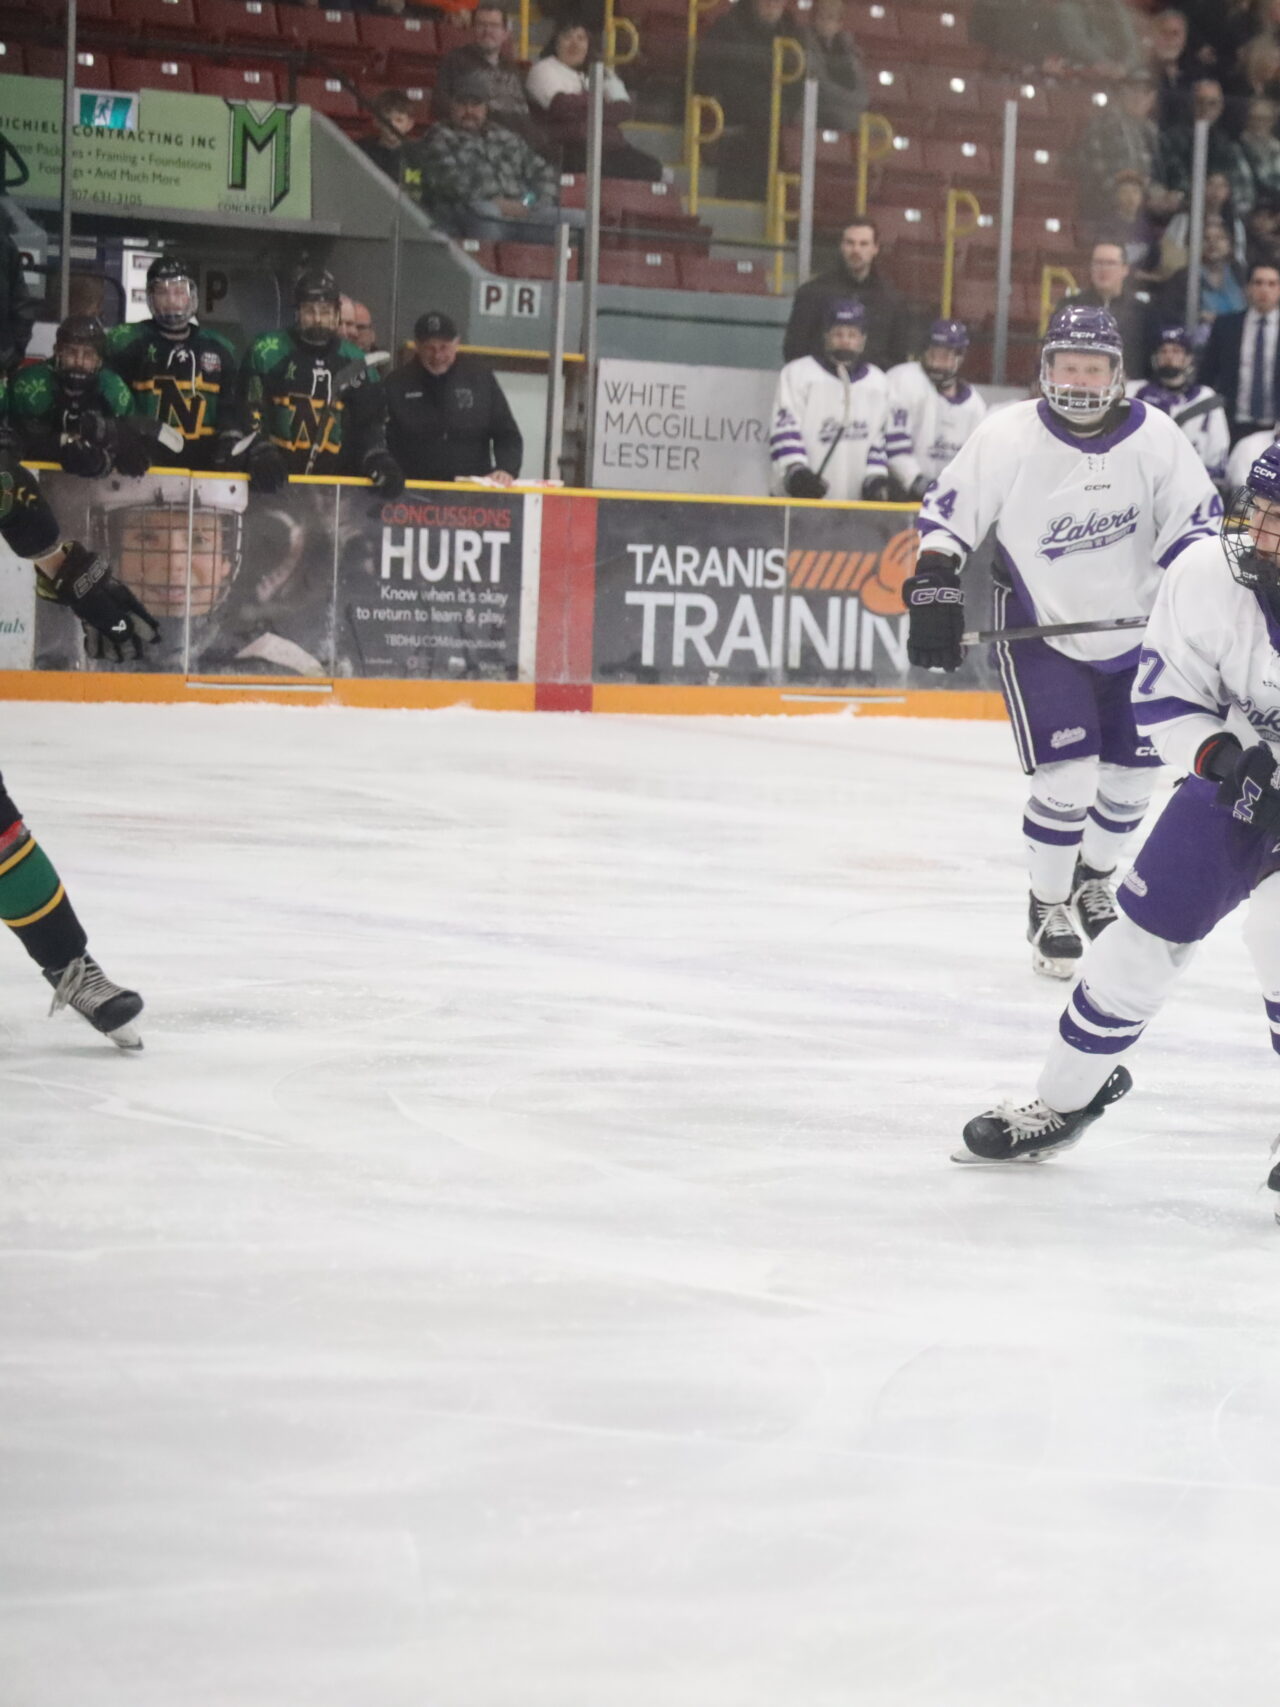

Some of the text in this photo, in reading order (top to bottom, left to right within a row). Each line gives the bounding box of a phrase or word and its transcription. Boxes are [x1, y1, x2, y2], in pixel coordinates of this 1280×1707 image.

[0, 115, 216, 150] ICHIEL CONTRACTING INC
[96, 147, 137, 166] Framing
[148, 153, 212, 171] Foundations
[95, 167, 117, 179] And
[120, 170, 149, 182] Much
[152, 173, 181, 185] More
[485, 285, 535, 314] P R
[604, 380, 687, 410] WHITE
[603, 443, 700, 471] LESTER
[1253, 465, 1277, 480] CCM
[1084, 483, 1111, 491] CCM
[381, 503, 512, 529] CONCUSSIONS
[1041, 505, 1140, 546] Lakers
[381, 526, 511, 583] HURT
[626, 543, 785, 588] TARANIS
[380, 585, 509, 607] Know when it's okay
[911, 587, 965, 606] CC
[356, 607, 370, 620] to
[373, 608, 412, 621] return
[415, 608, 428, 622] to
[431, 607, 463, 623] learn
[465, 608, 476, 624] &
[624, 591, 910, 671] TRAININ
[1135, 747, 1159, 757] CC
